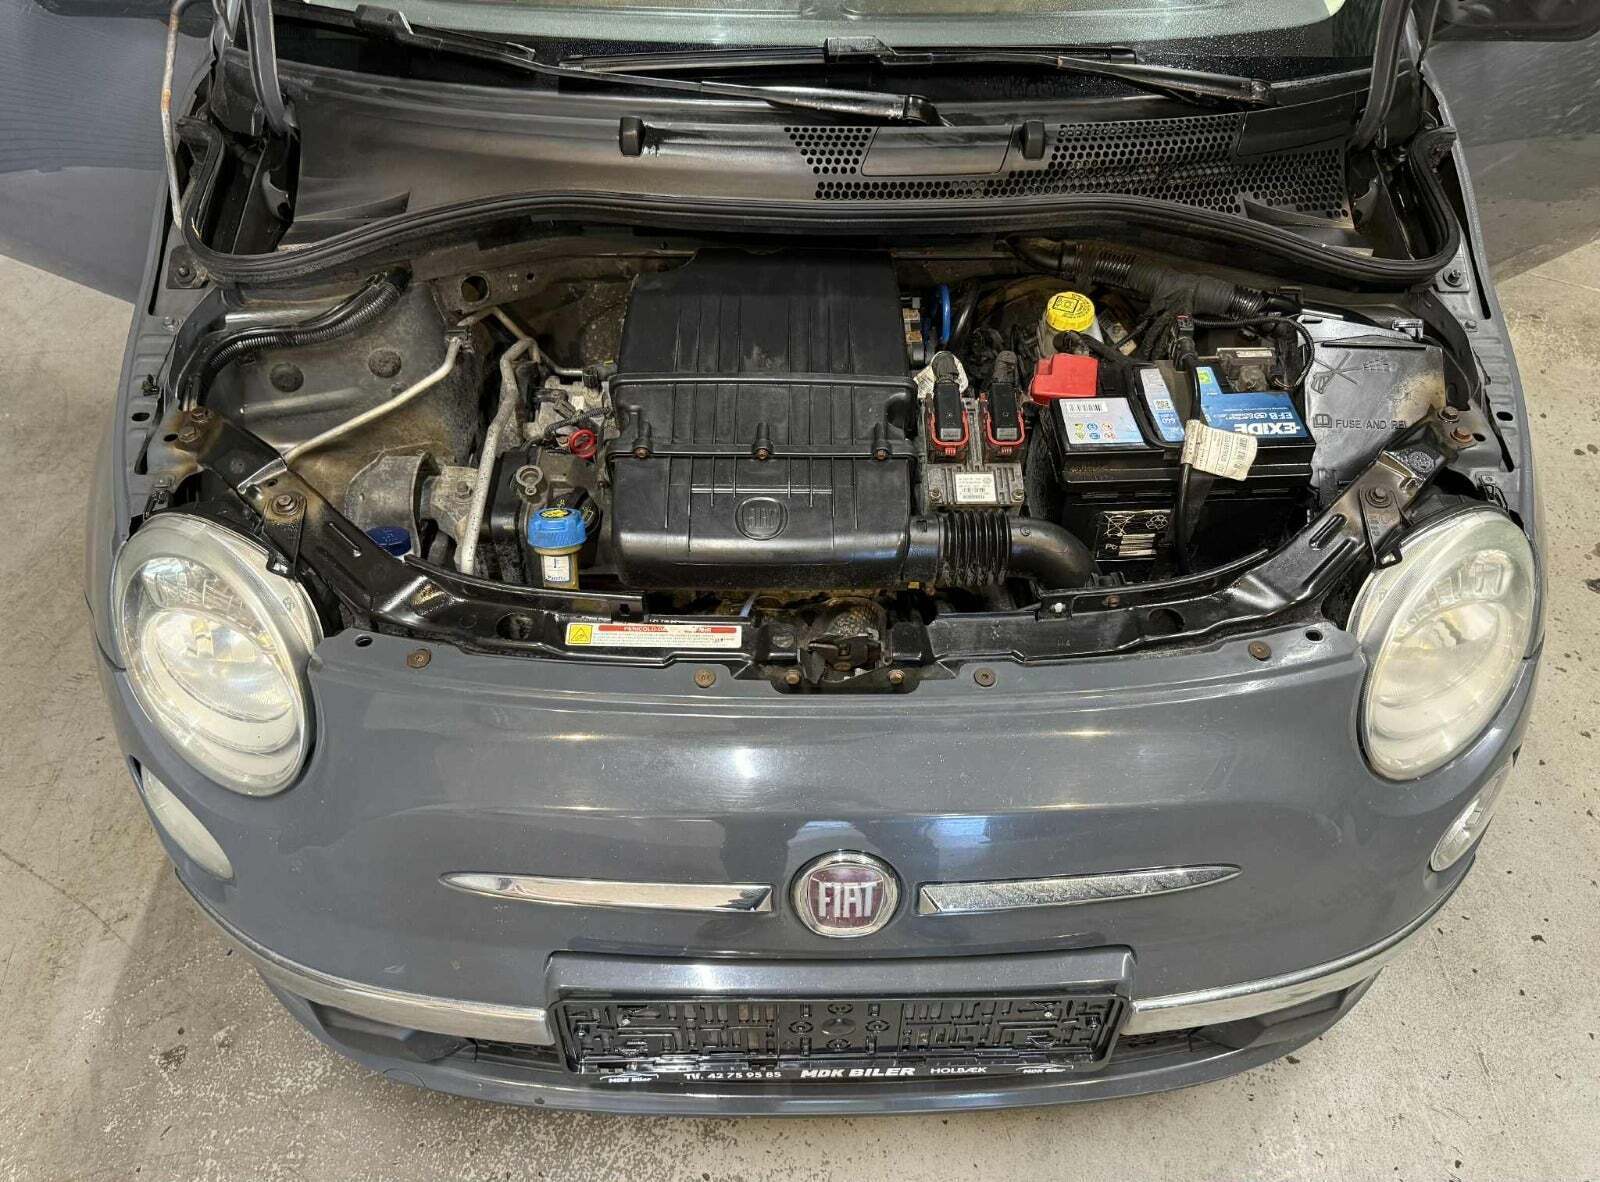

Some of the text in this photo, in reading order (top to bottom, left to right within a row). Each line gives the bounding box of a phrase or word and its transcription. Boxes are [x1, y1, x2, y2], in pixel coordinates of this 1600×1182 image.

[1270, 411, 1293, 420] EFB
[1234, 422, 1298, 435] EXIDE
[1335, 419, 1362, 429] FUSE
[1366, 420, 1387, 430] AND
[748, 507, 778, 529] FIAT
[818, 881, 878, 918] FIAT
[800, 1069, 844, 1078] MDK
[849, 1067, 916, 1078] BILER
[930, 1066, 987, 1074] HOLBÆK
